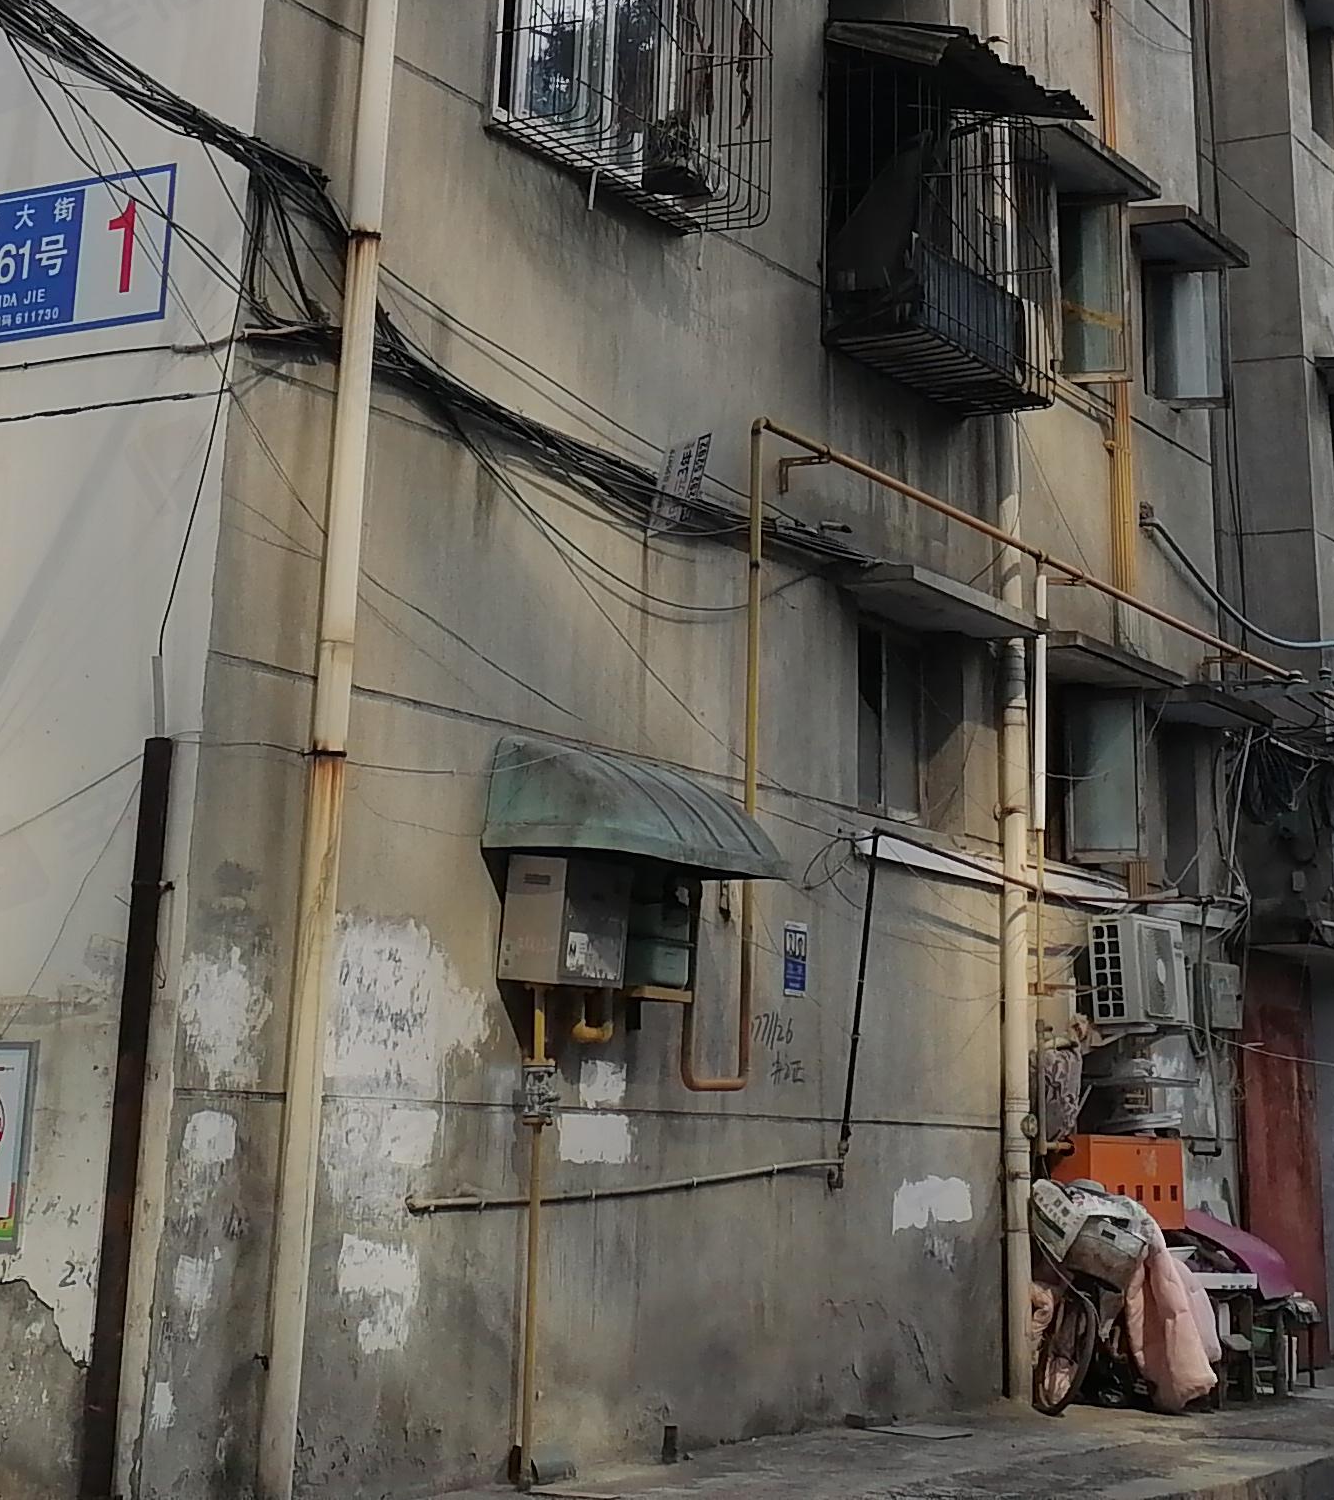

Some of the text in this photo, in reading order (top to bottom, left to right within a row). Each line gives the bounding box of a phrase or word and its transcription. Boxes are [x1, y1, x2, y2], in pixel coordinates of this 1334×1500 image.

[108, 195, 136, 293] 1
[23, 288, 46, 305] JIE
[15, 307, 59, 325] 611730
